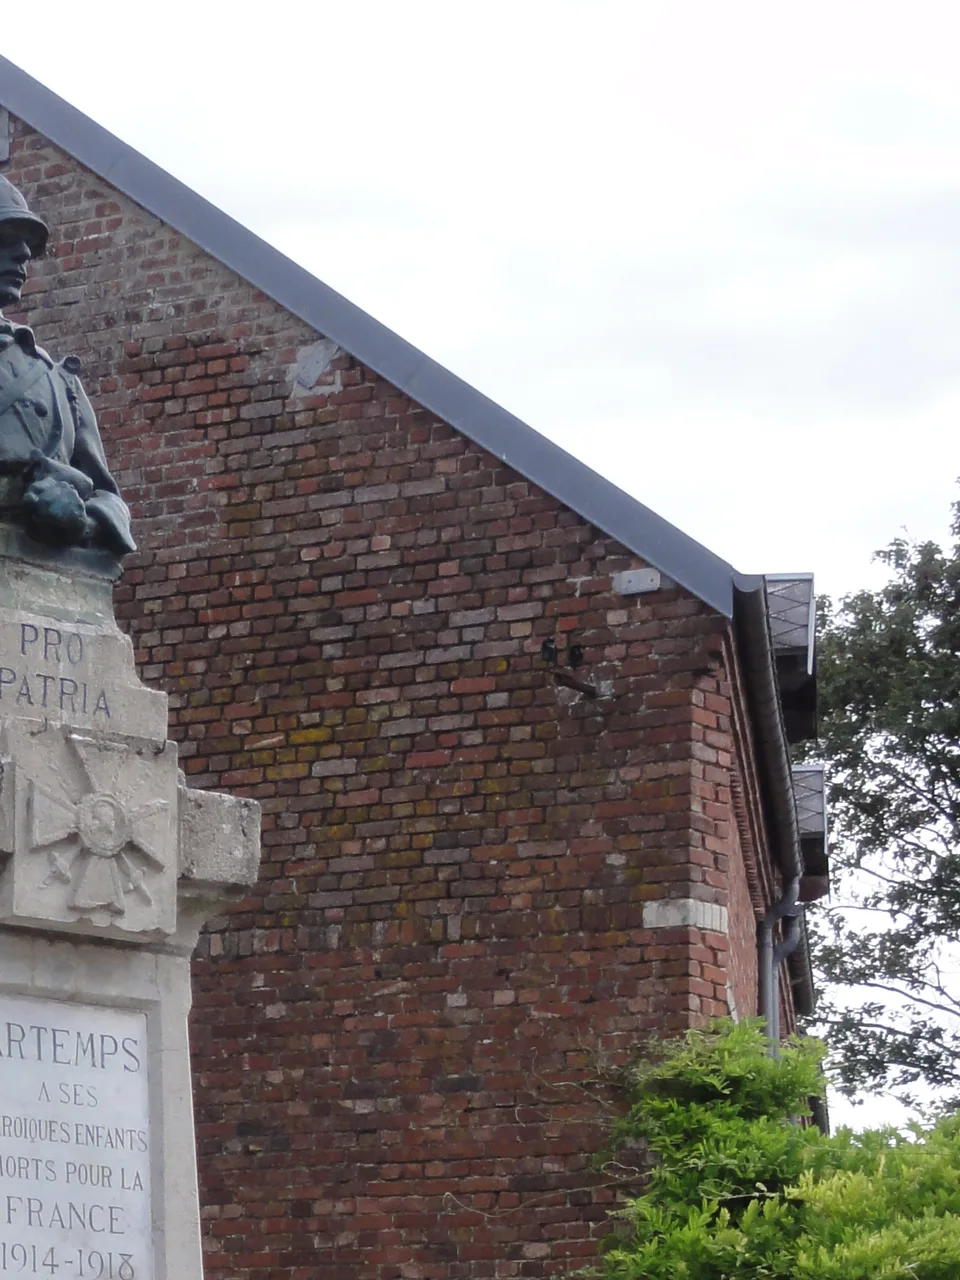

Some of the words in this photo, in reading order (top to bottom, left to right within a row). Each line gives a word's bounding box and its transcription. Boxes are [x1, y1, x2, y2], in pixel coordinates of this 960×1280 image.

[21, 623, 83, 664] PRO
[38, 1081, 51, 1103] A
[59, 1082, 98, 1108] SES
[75, 1123, 148, 1153] ENFANTS
[65, 1161, 113, 1188] POUR
[120, 1167, 144, 1192] LA
[6, 1195, 125, 1235] FRANCE
